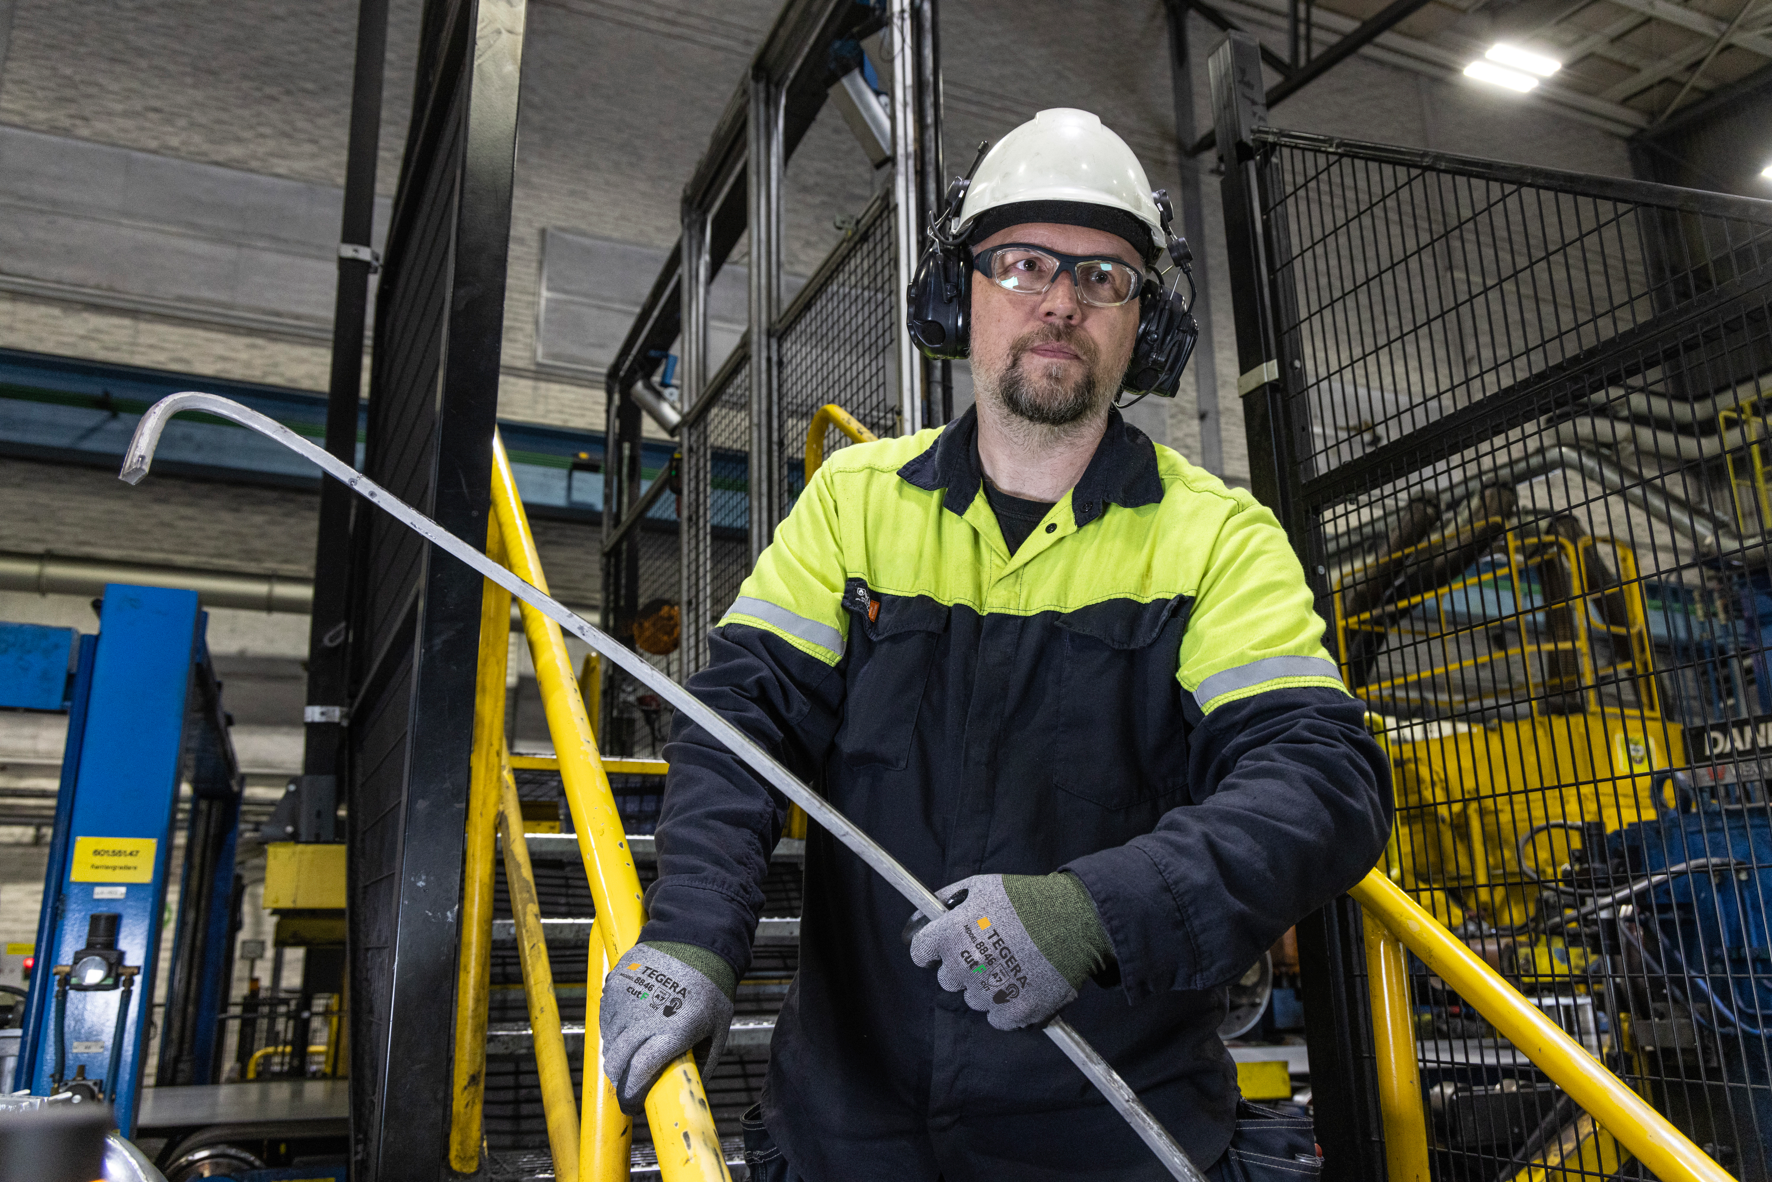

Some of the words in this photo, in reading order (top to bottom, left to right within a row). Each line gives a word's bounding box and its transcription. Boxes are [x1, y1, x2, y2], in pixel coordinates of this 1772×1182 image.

[964, 924, 977, 944] MODEL
[975, 941, 997, 966] 8846
[988, 929, 1027, 989] TEGERA
[634, 977, 655, 992] 8846
[642, 966, 687, 999] TEGERA
[992, 972, 1003, 983] A7
